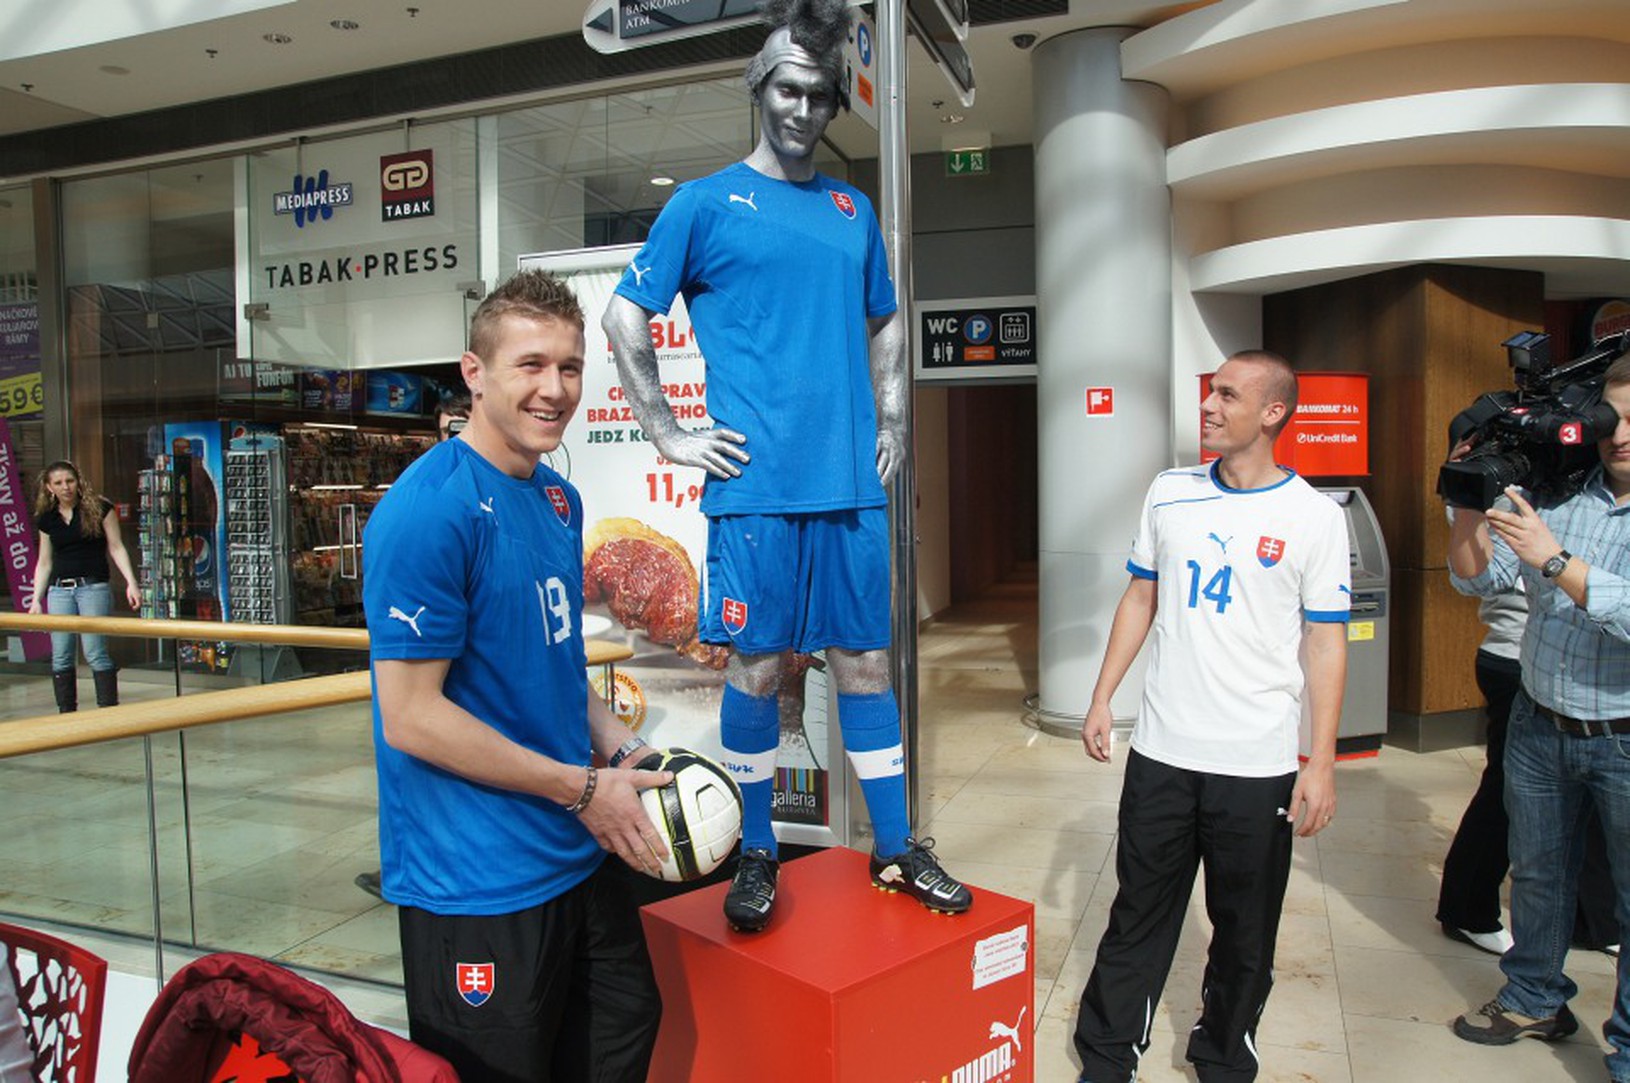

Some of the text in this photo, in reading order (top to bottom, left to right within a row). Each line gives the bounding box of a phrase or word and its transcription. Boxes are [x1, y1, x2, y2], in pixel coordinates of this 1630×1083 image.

[626, 0, 690, 15] BANKOM
[625, 16, 650, 29] ATM
[859, 29, 869, 59] P
[276, 186, 350, 211] MEDIAPRESS
[385, 200, 431, 218] TABAK
[927, 317, 987, 340] WC P
[1342, 404, 1352, 414] 24
[587, 429, 624, 444] JEDZ
[1563, 426, 1577, 442] 3
[3, 511, 26, 538] až
[10, 541, 29, 569] do
[1187, 559, 1233, 614] 14
[535, 576, 572, 646] 19
[771, 790, 817, 808] galleria
